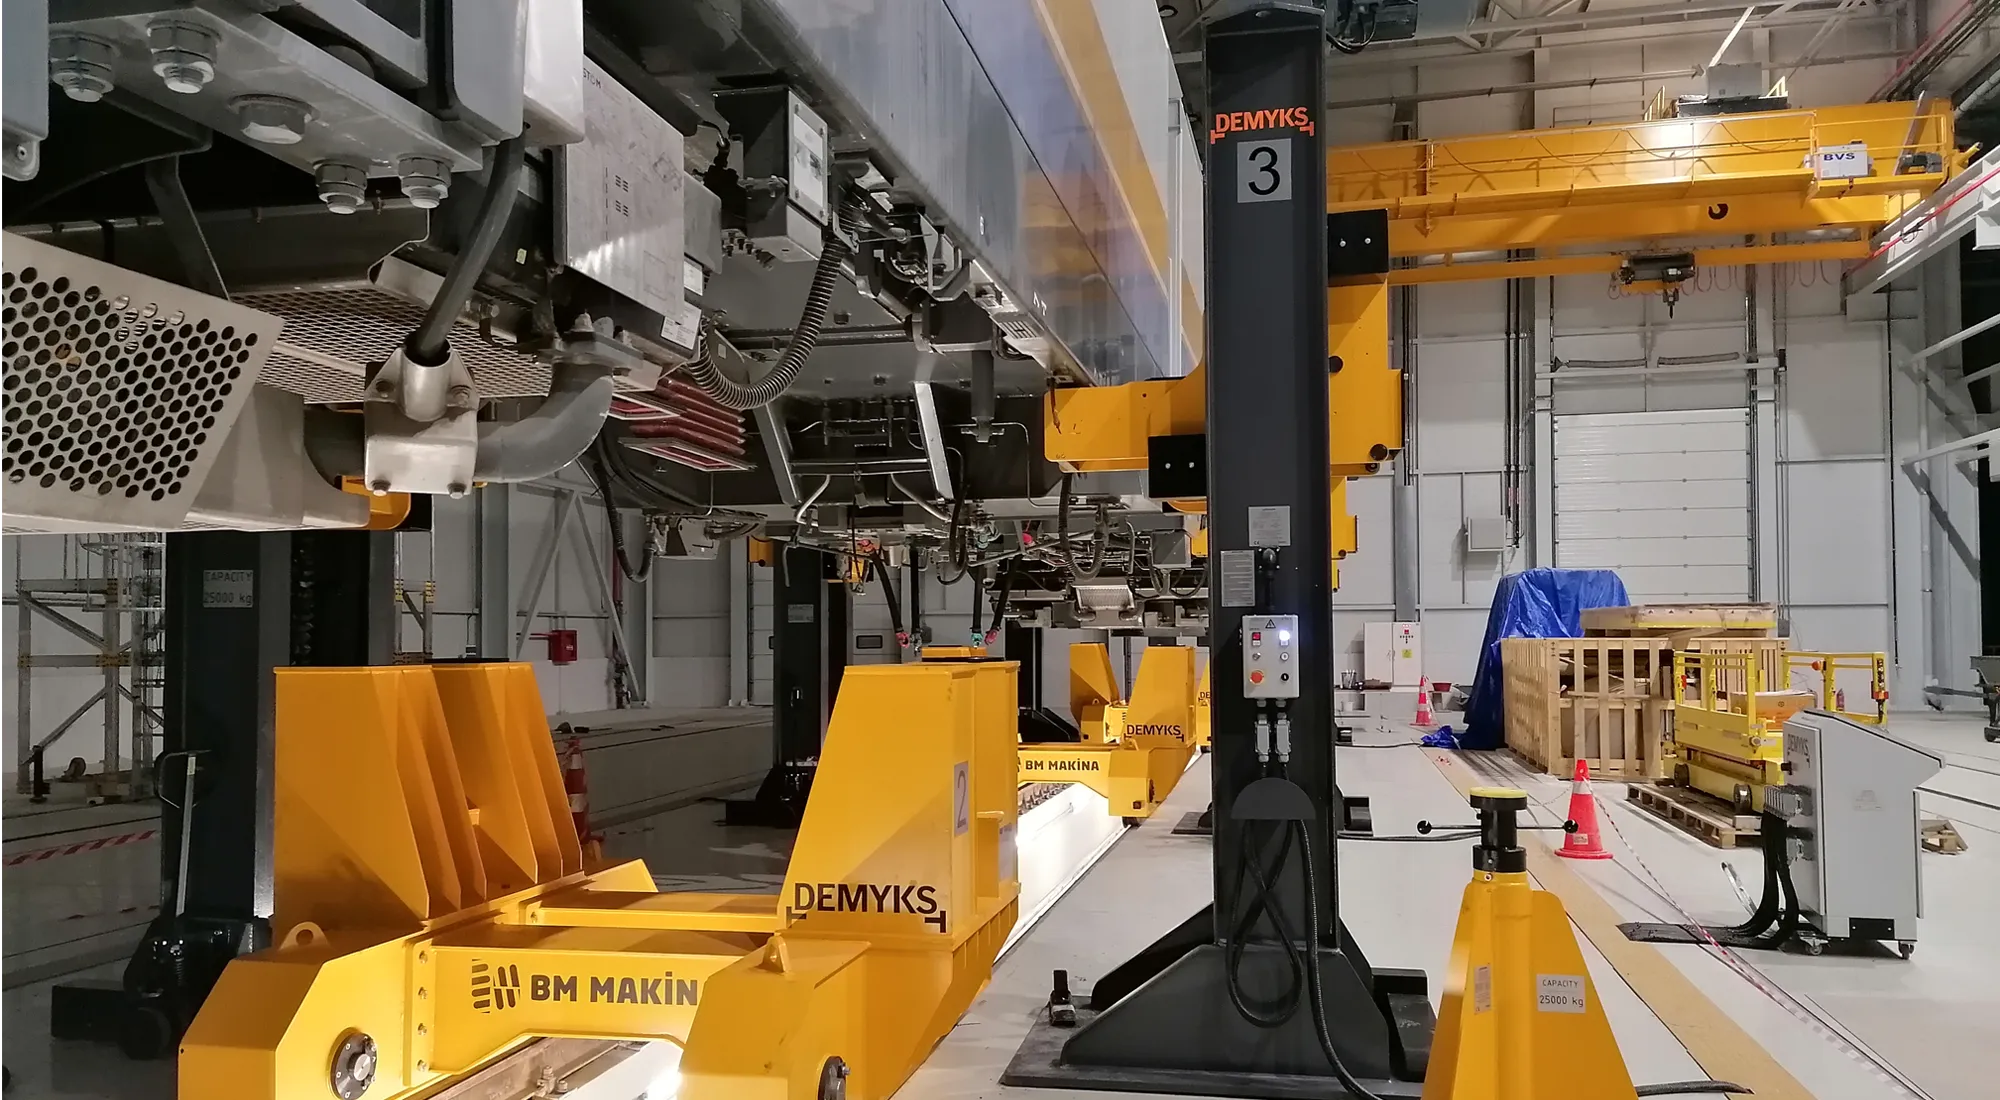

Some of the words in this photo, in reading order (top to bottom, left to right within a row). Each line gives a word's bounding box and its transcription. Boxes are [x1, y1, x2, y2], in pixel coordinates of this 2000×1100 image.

[1215, 106, 1309, 133] DEMYKS
[1823, 152, 1856, 161] BVS
[1248, 146, 1281, 196] 3
[1126, 724, 1181, 736] DEMYKS
[1025, 760, 1044, 770] BM
[1048, 757, 1100, 771] MAKİNA
[957, 770, 967, 829] 2
[794, 882, 938, 915] DEMYKS
[531, 974, 578, 1002] BM
[590, 971, 698, 1006] MAKİN
[1542, 979, 1579, 988] CAPACITY
[1539, 995, 1568, 1005] 25000
[1572, 996, 1584, 1008] kg
